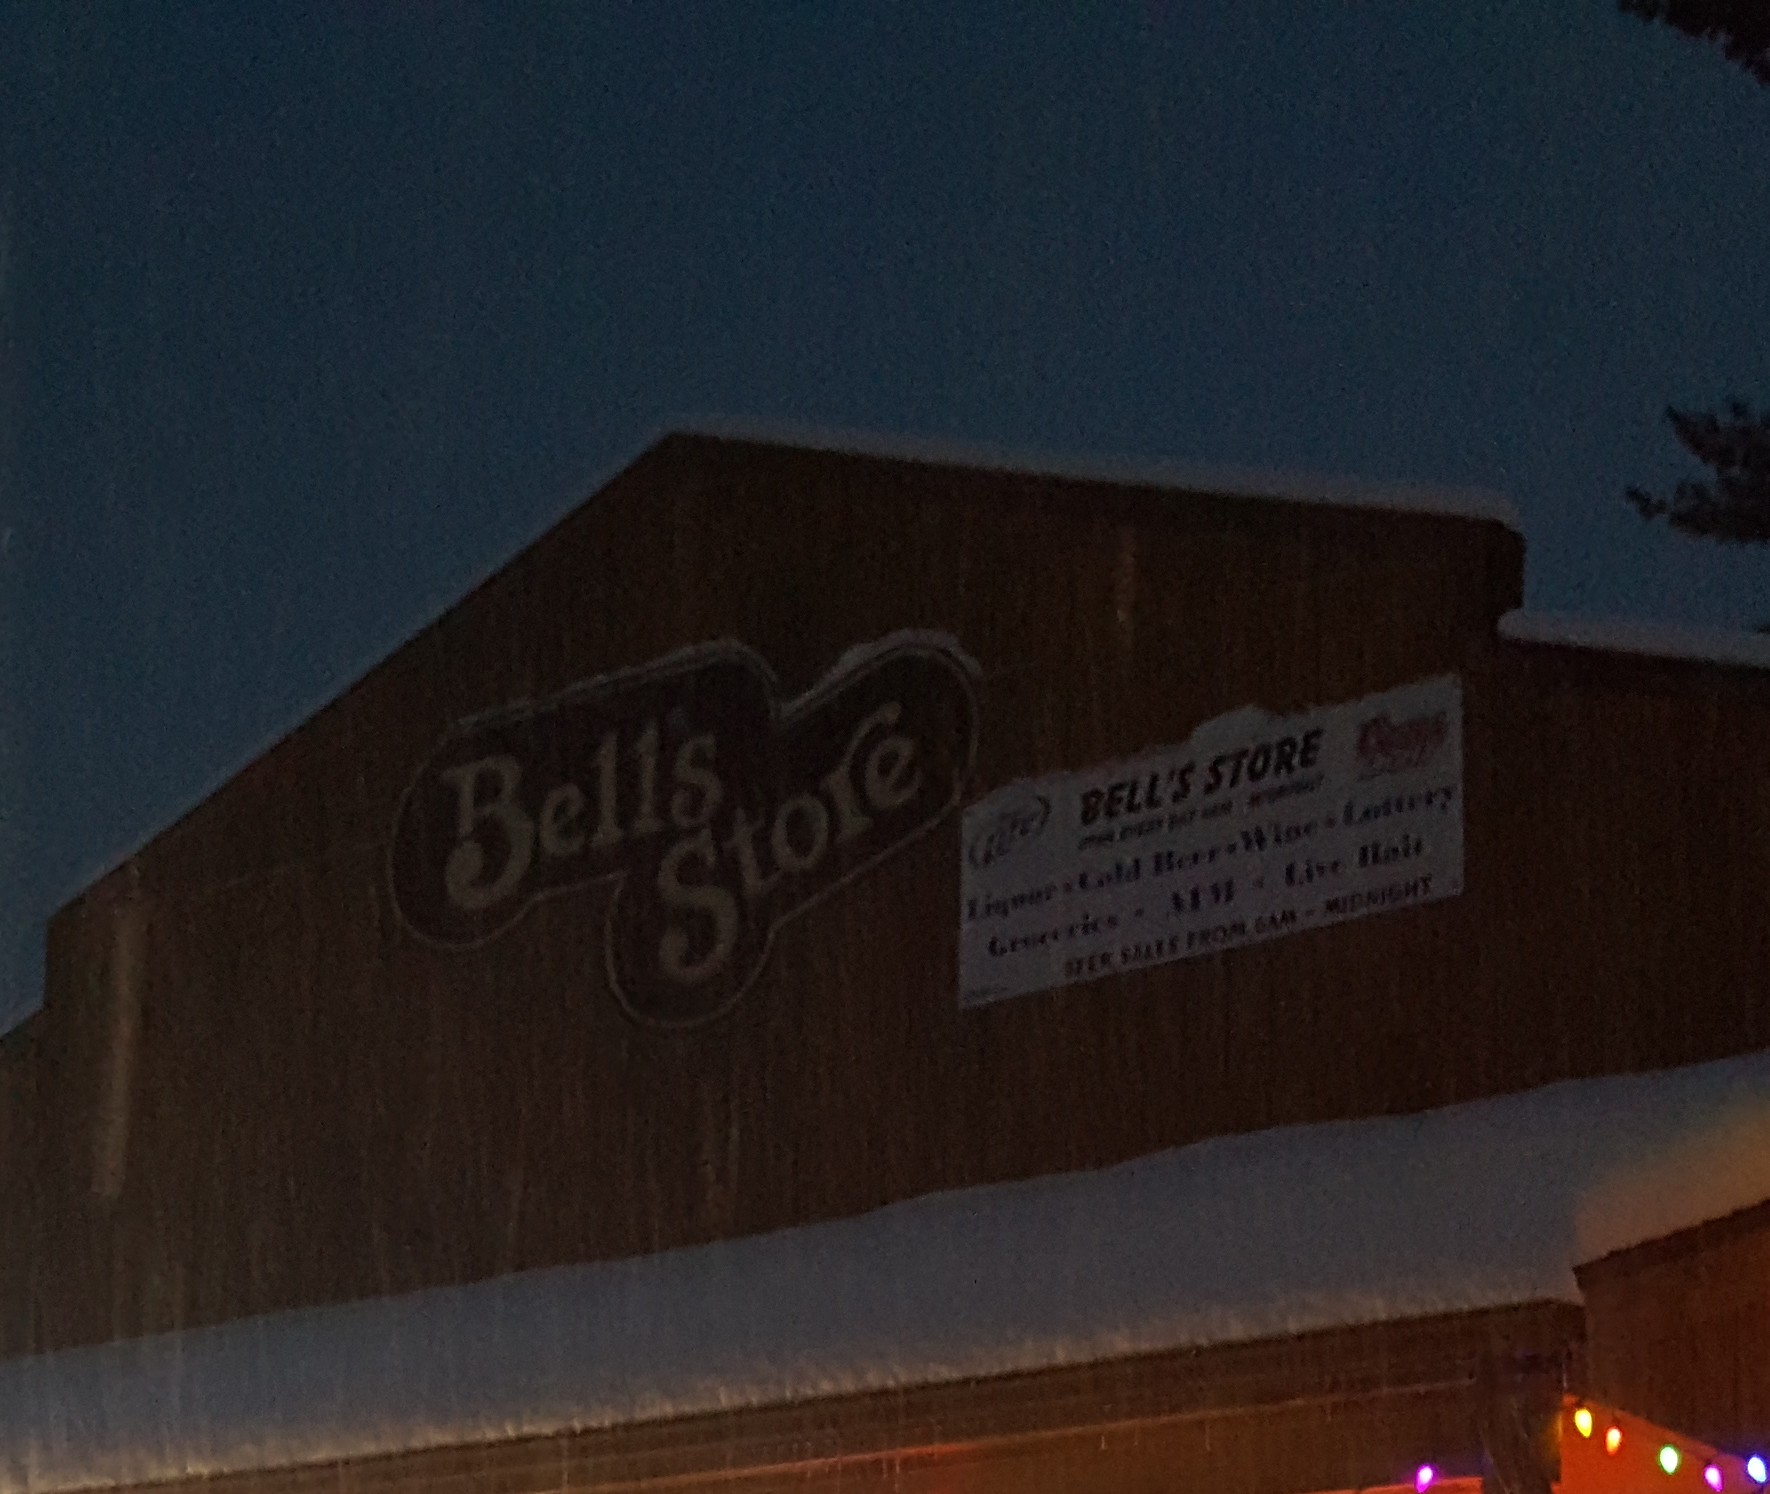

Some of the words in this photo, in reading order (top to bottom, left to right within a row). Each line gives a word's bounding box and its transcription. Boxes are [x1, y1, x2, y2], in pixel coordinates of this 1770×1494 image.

[657, 702, 925, 986] Store
[1081, 763, 1194, 826] BELL'S
[1204, 728, 1324, 796] STORE
